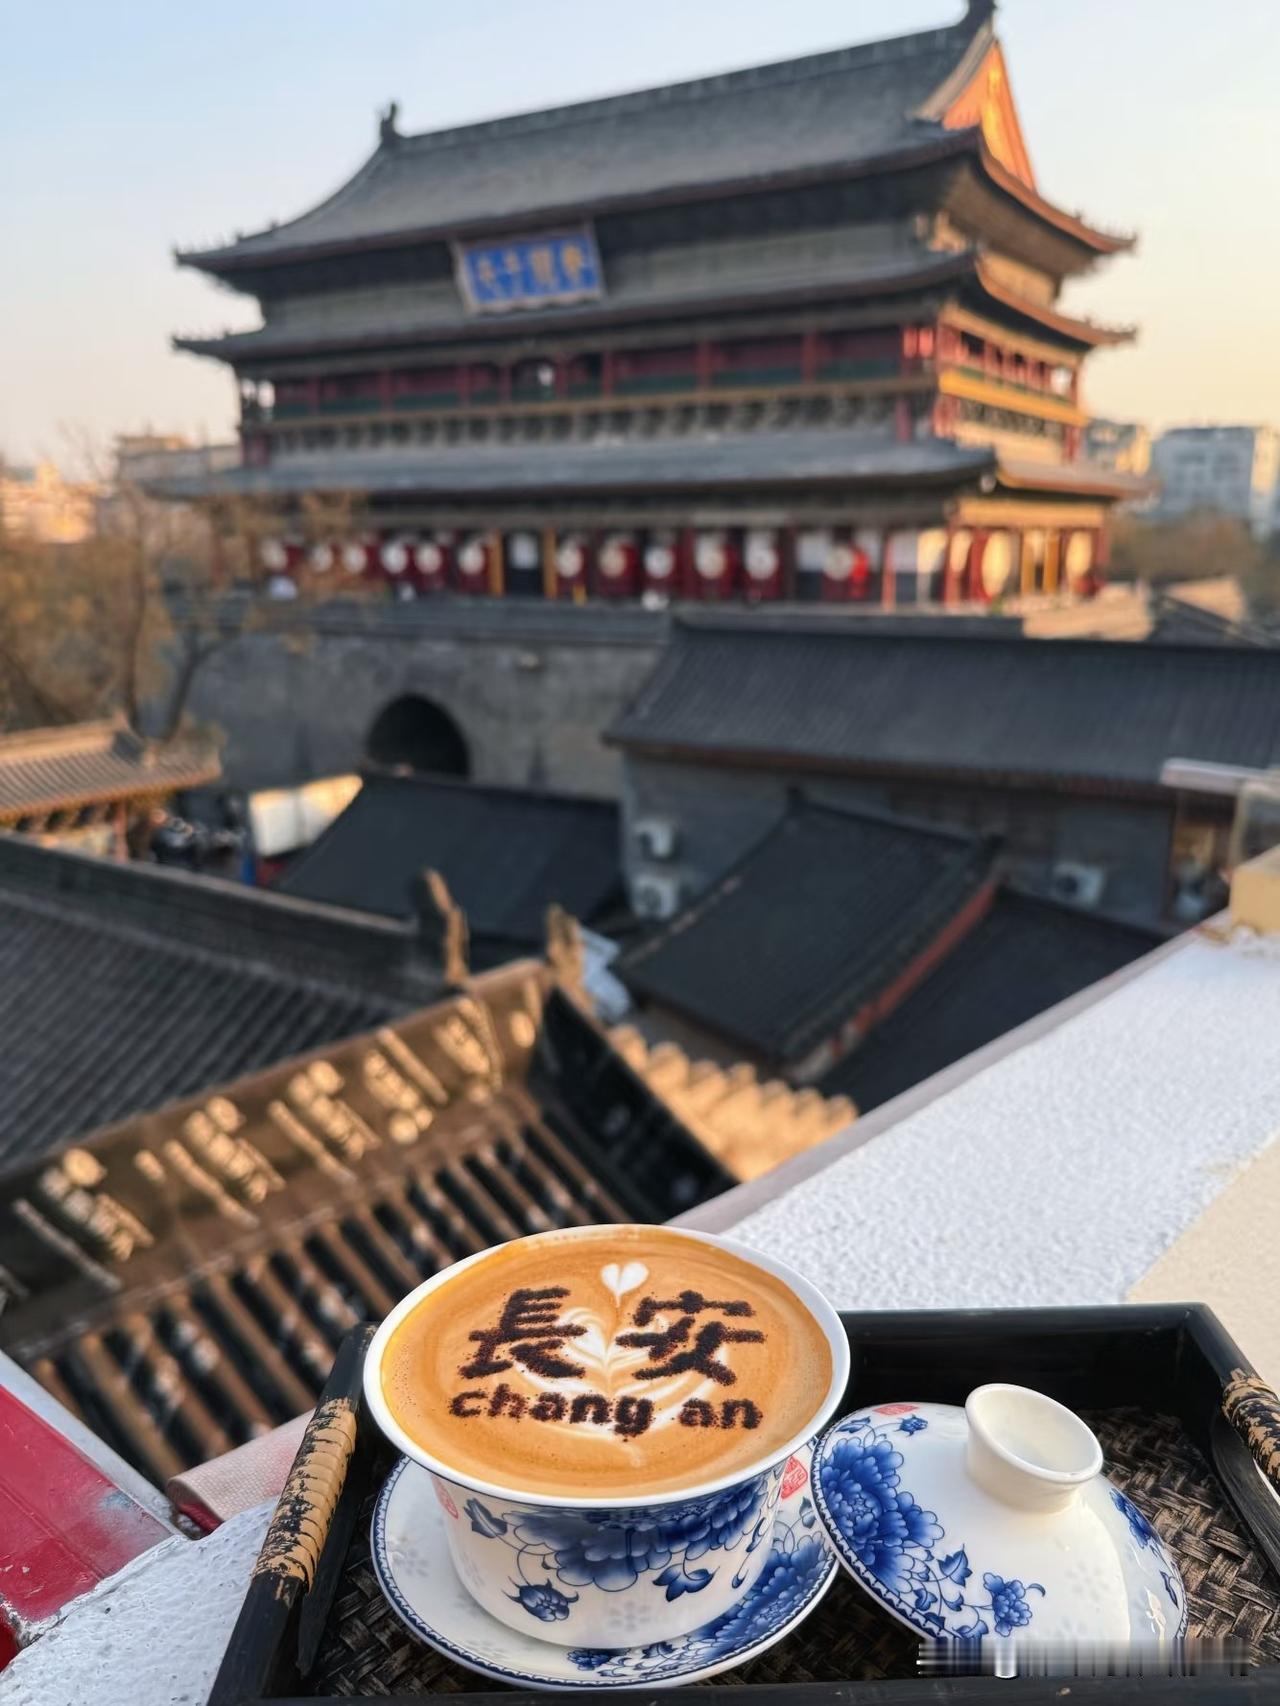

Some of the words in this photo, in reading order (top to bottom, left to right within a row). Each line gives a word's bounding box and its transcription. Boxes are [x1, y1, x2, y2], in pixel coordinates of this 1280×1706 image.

[458, 1286, 766, 1386] 長安
[449, 1384, 653, 1439] chang
[678, 1397, 762, 1430] an
